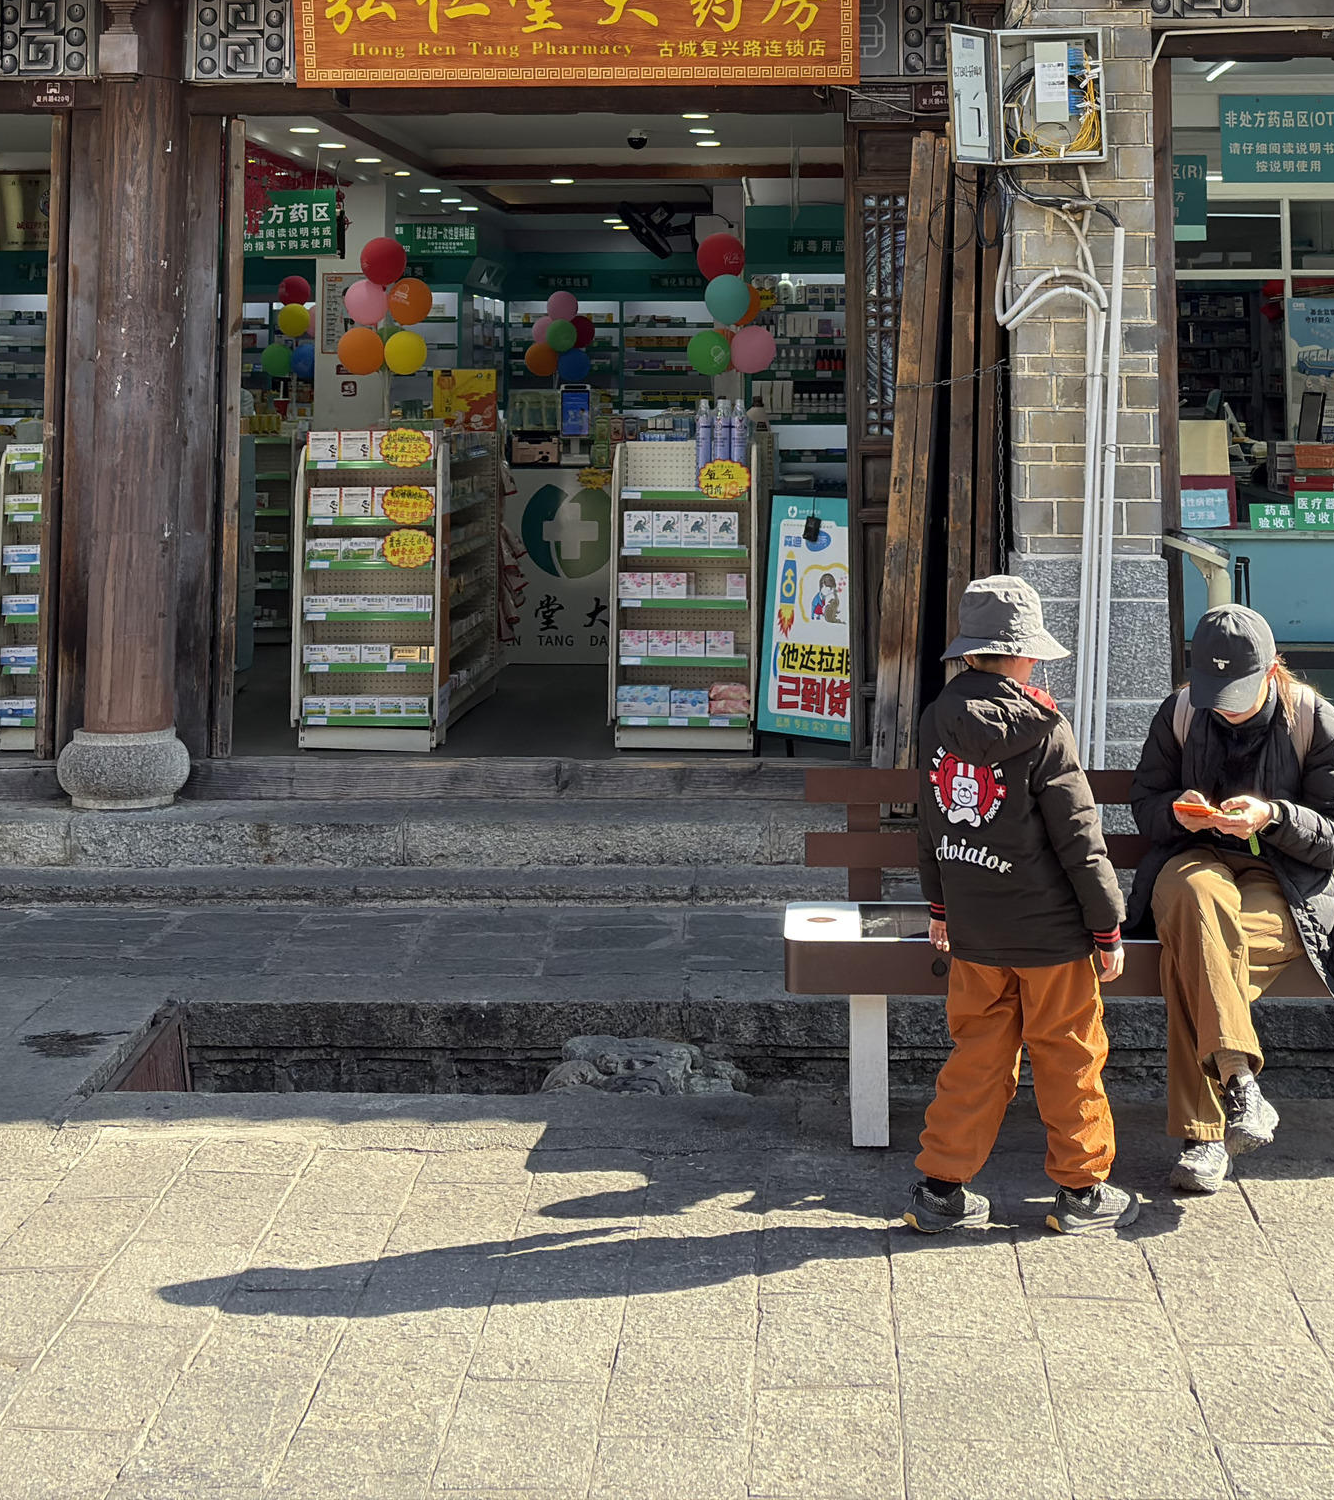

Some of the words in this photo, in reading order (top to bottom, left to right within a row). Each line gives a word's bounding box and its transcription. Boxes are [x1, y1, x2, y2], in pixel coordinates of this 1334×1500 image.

[351, 41, 406, 59] Hong
[416, 41, 458, 57] Ren
[467, 41, 520, 59] Tang
[530, 41, 635, 59] Pharmacy
[656, 39, 827, 58] 古城复兴路连锁店
[1255, 160, 1322, 173] 按说明使用
[792, 239, 846, 253] 消毒用品
[1264, 504, 1291, 516] 药品
[537, 634, 574, 647] TANG
[777, 675, 851, 718] 已到货
[936, 835, 1014, 874] Aviator
